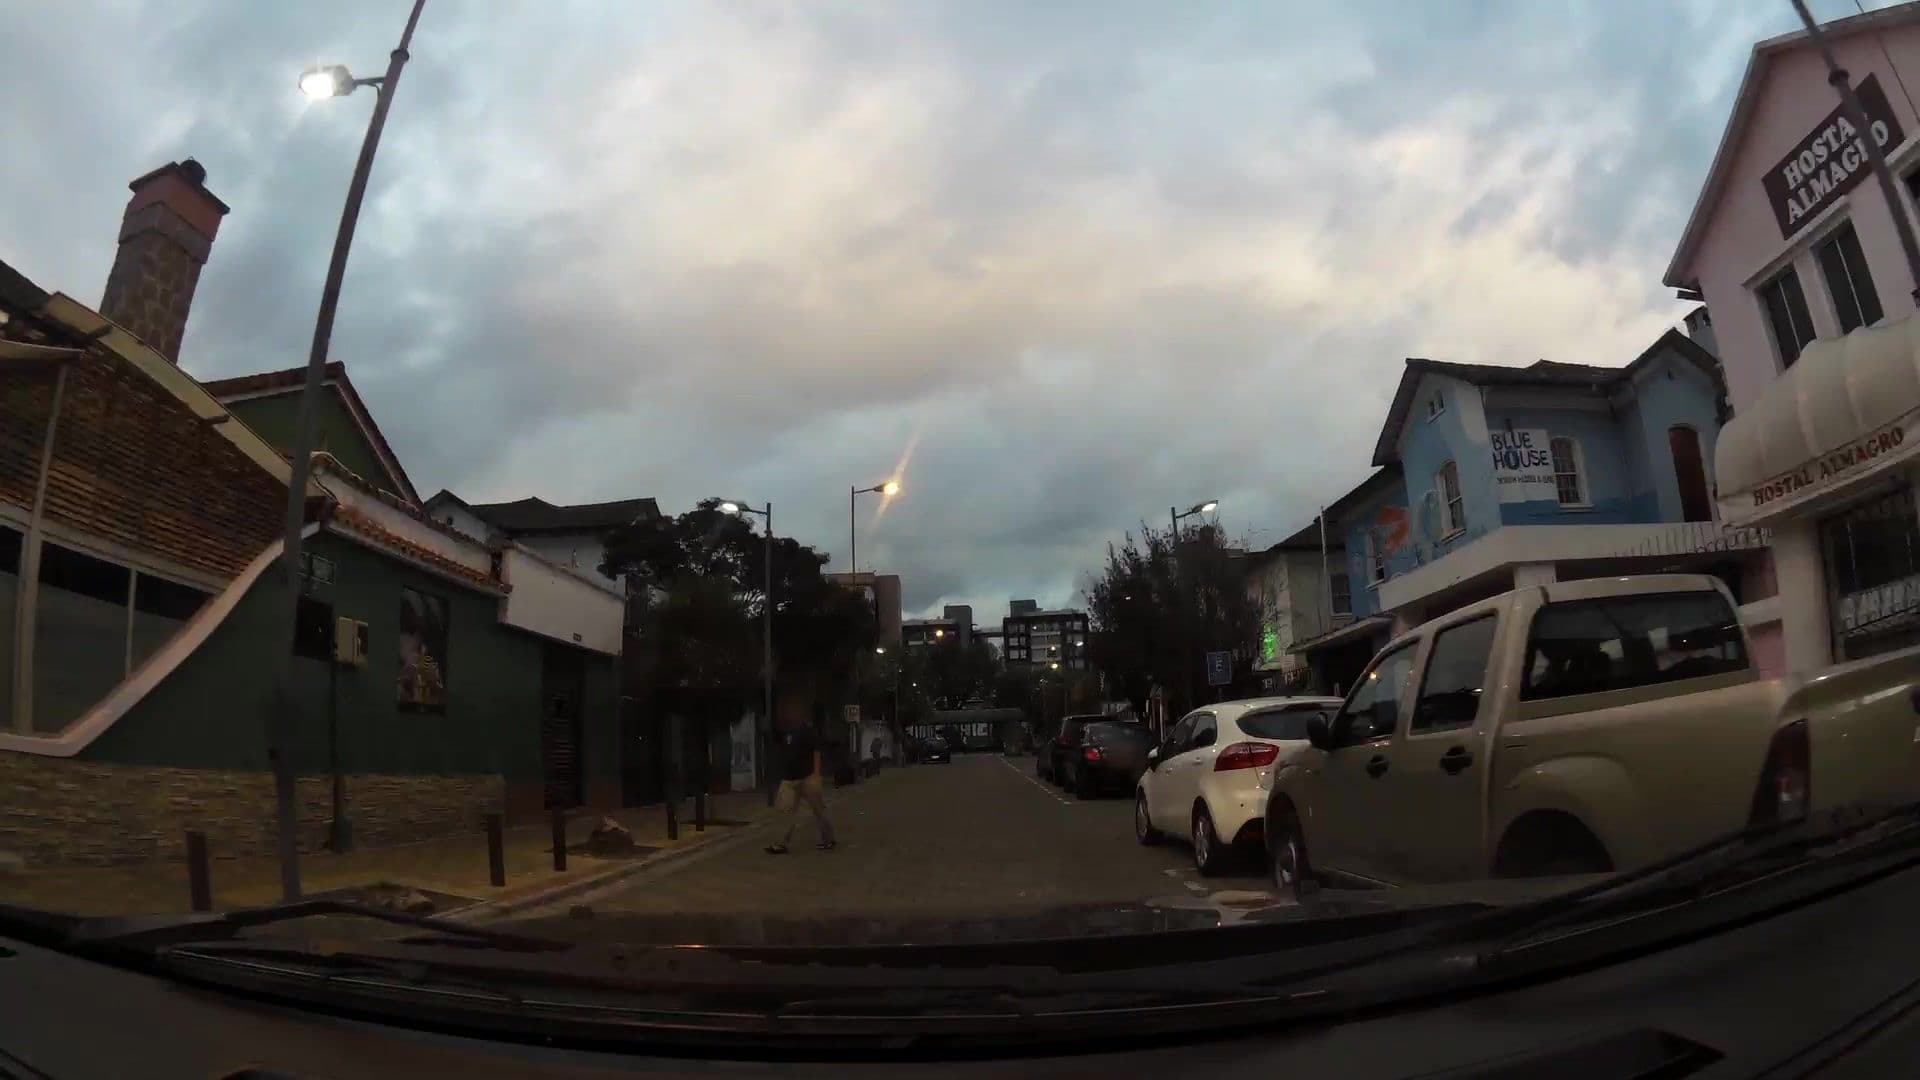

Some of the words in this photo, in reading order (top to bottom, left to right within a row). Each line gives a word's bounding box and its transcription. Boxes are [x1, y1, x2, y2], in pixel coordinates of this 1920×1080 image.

[1782, 113, 1864, 190] HOSTA
[1491, 431, 1533, 451] BLUE
[1493, 449, 1549, 470] HOUSE
[1753, 467, 1814, 506] HOSTAL
[1819, 426, 1905, 480] ALMAGRO
